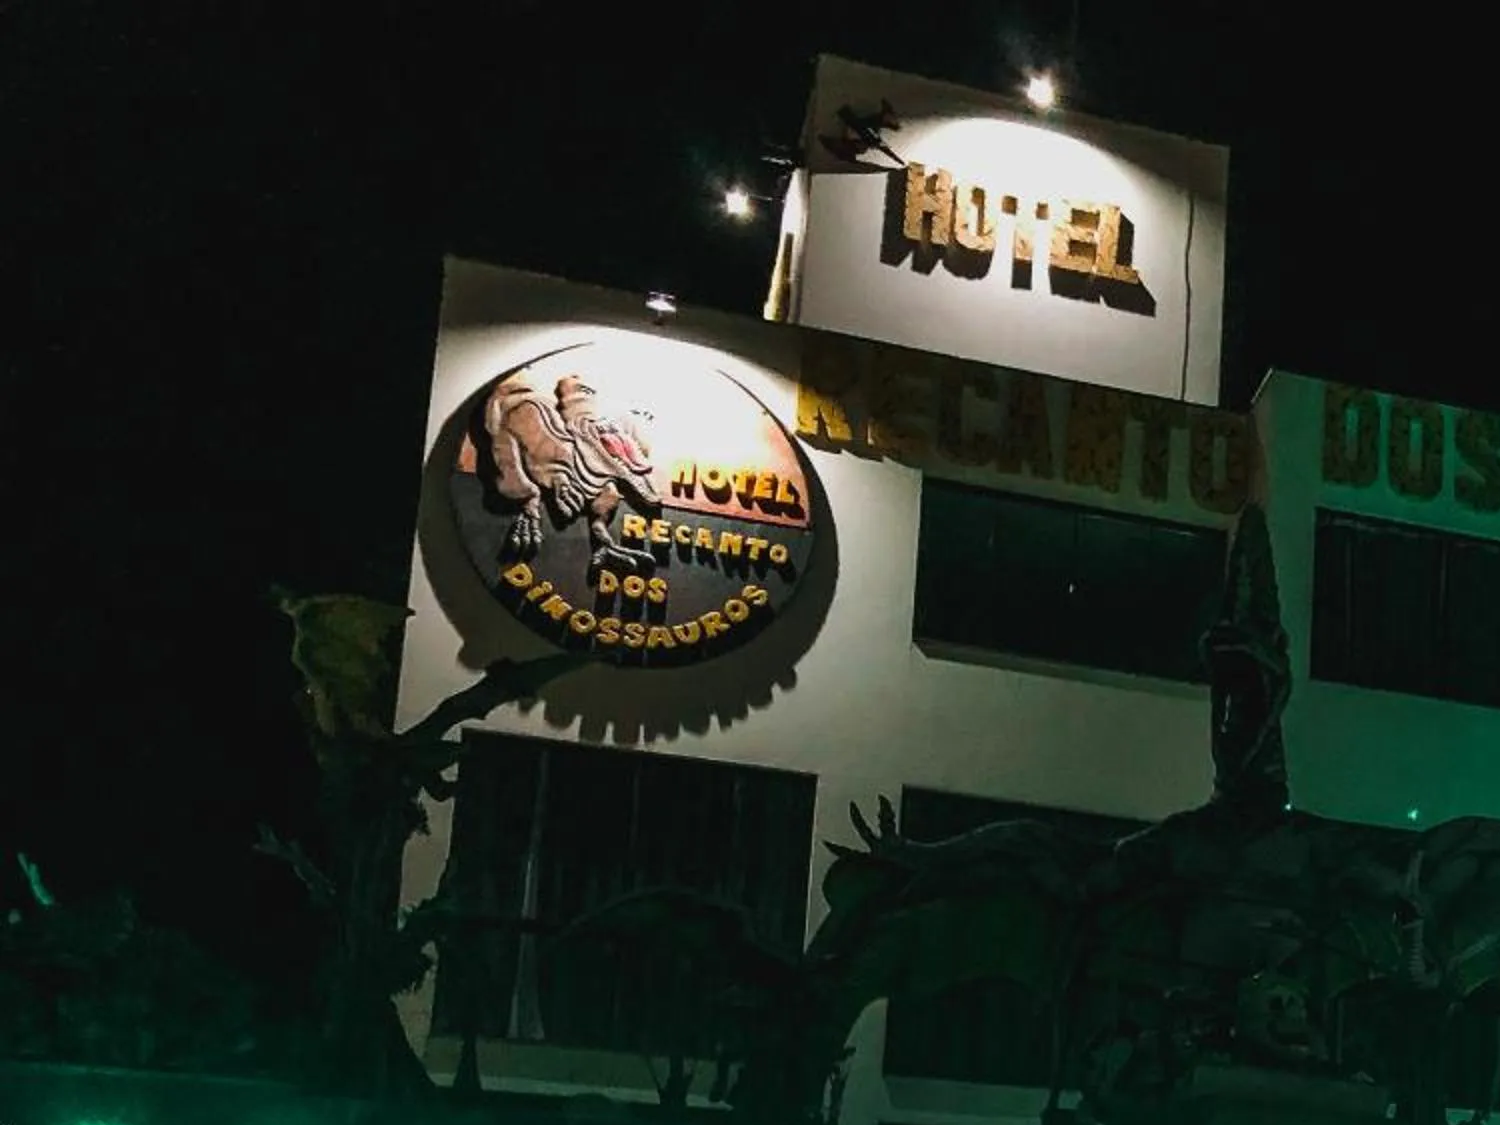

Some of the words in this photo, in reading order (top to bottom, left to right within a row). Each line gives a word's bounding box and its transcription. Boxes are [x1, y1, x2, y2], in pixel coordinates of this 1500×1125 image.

[901, 160, 1142, 285] HOTEL
[797, 332, 1249, 514] RECANTO
[670, 462, 801, 506] HOTEL
[621, 512, 790, 565] RECANTO
[598, 570, 669, 603] DOS
